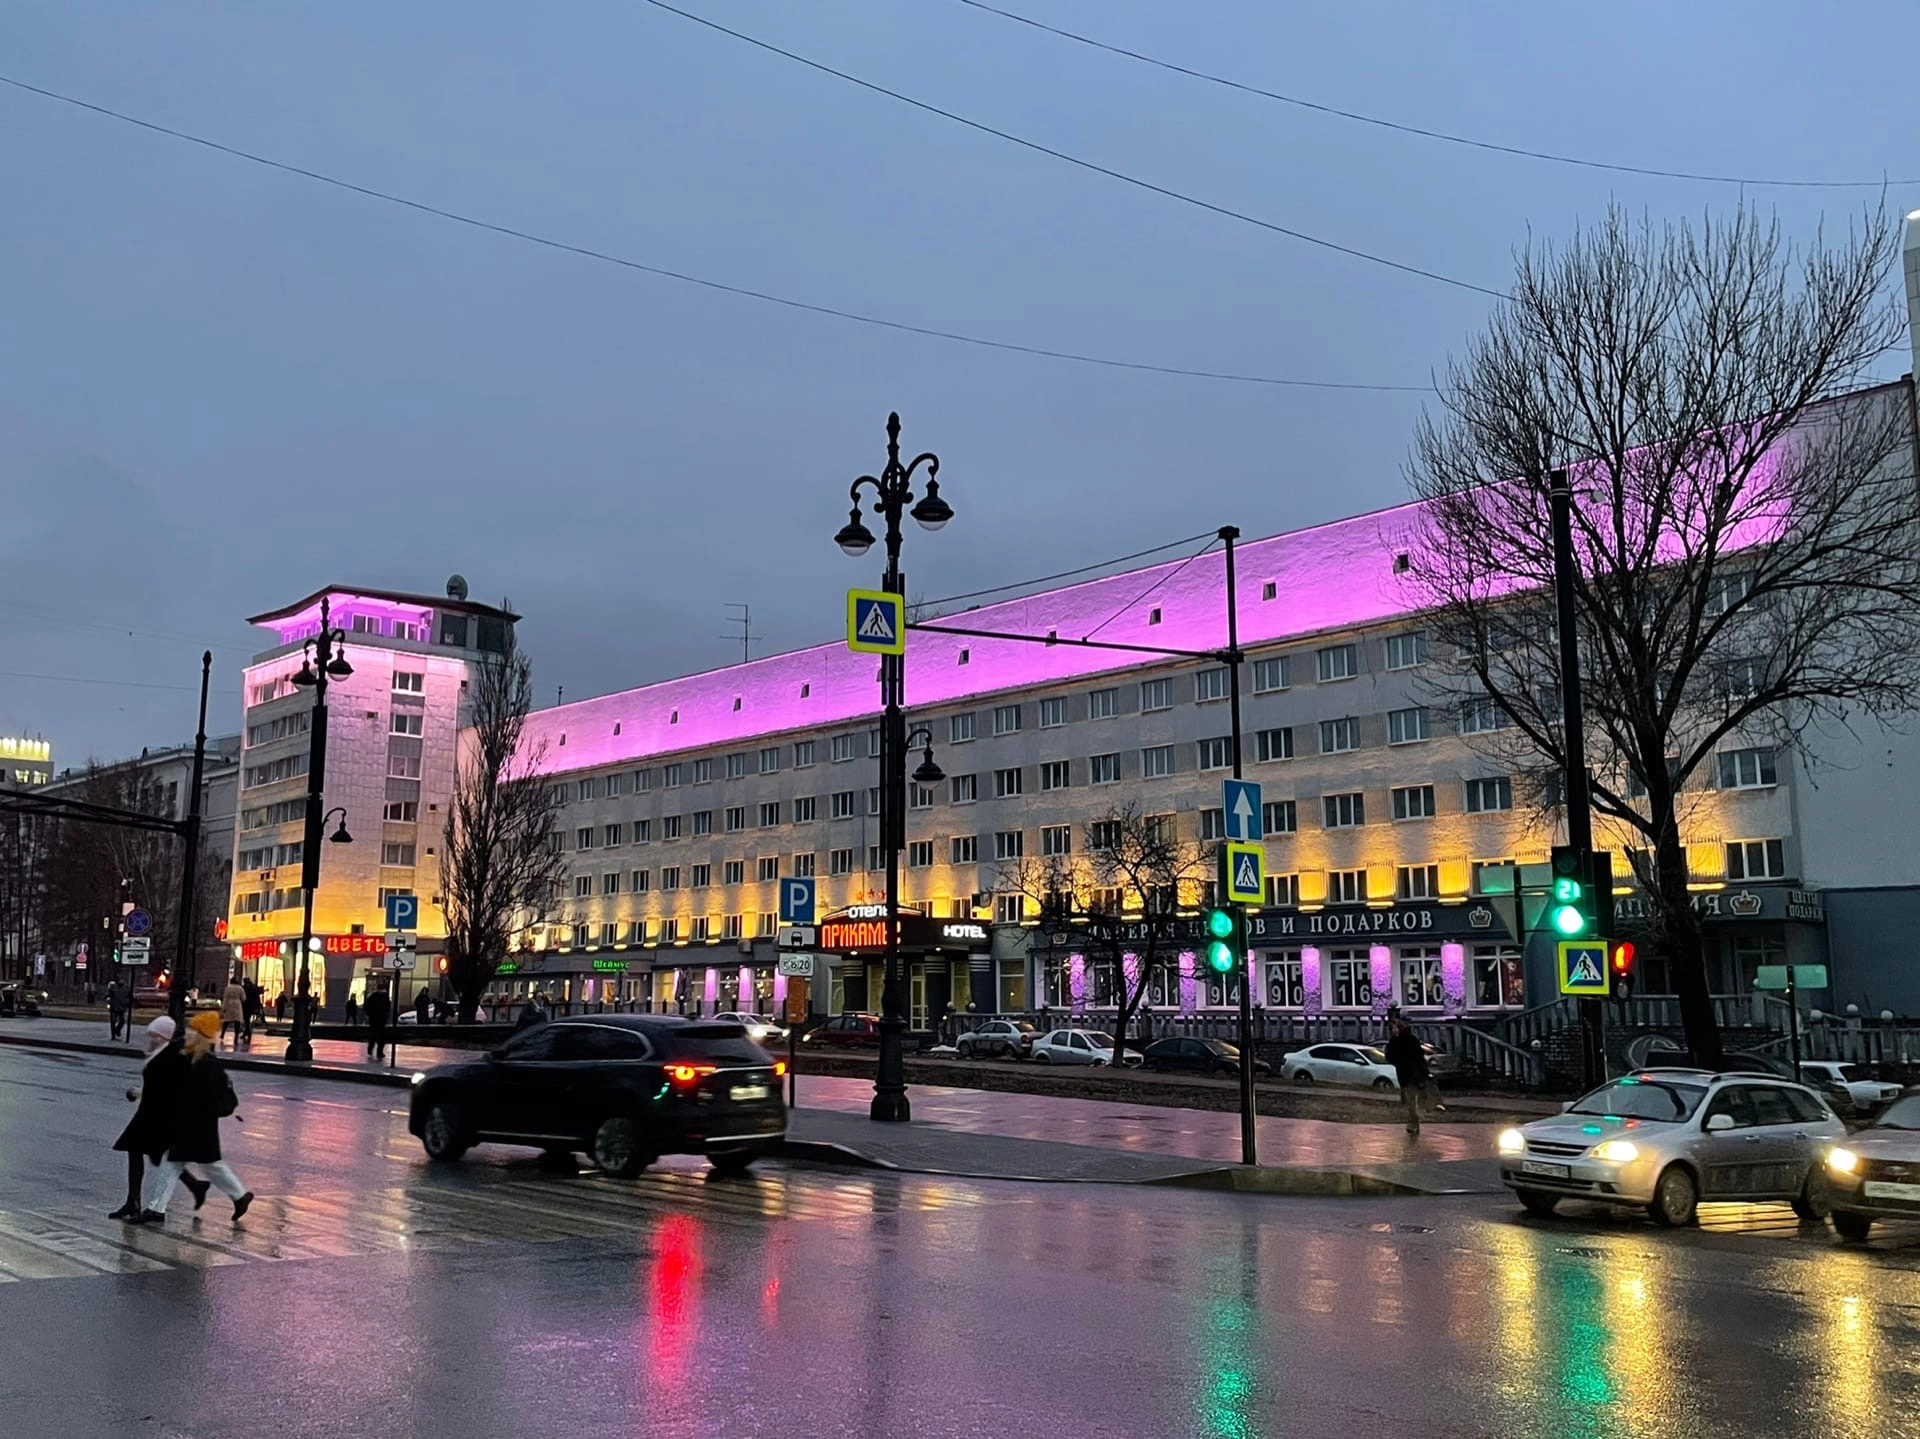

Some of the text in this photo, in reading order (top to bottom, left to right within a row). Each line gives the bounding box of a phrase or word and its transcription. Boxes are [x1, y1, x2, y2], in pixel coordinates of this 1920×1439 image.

[394, 899, 413, 926] P
[789, 882, 809, 918] P
[943, 924, 987, 938] HOTEL
[1281, 916, 1295, 934] И
[1310, 910, 1433, 934] ПОДАРКОВ
